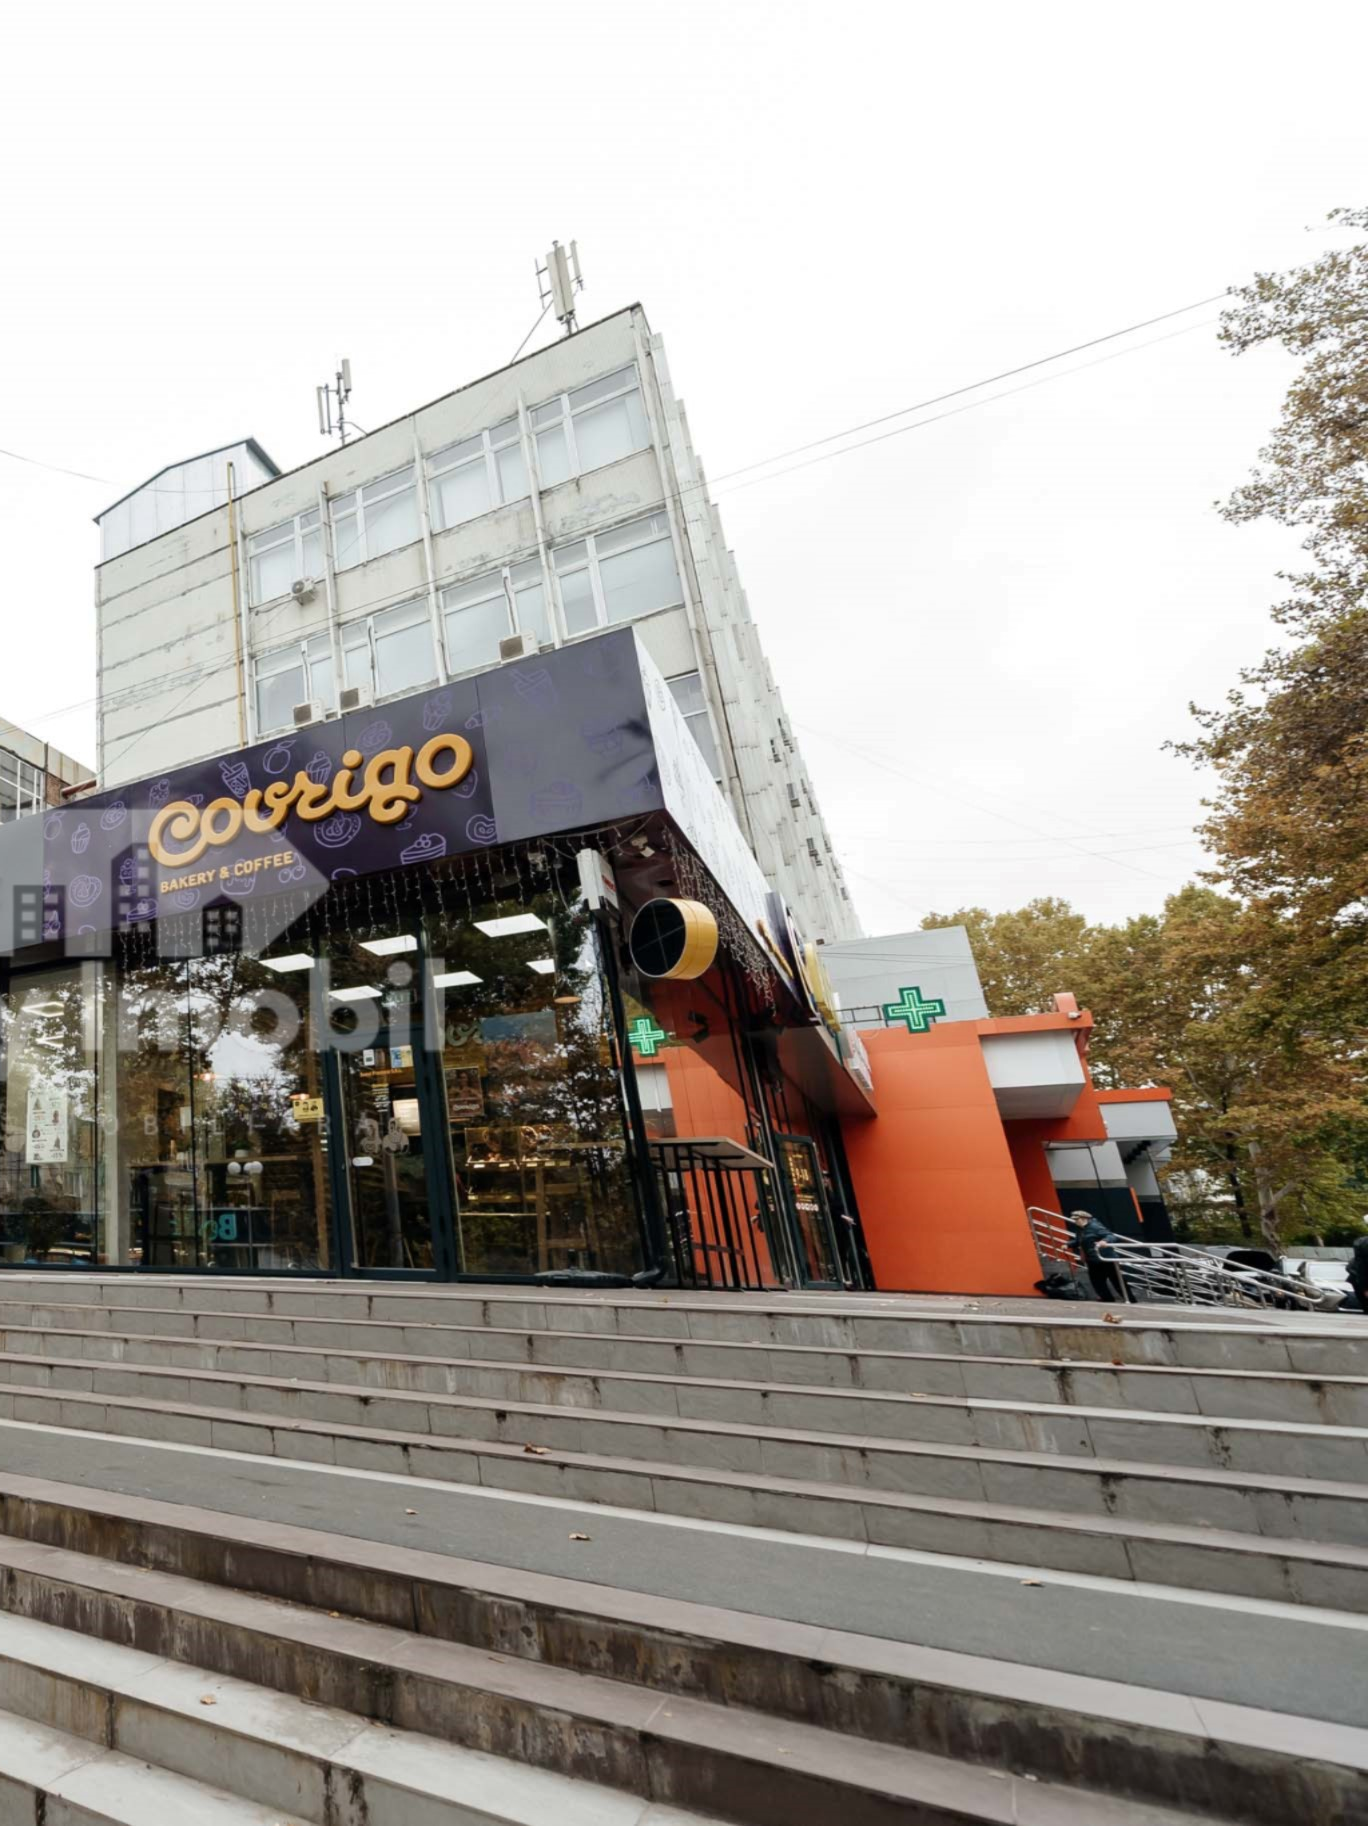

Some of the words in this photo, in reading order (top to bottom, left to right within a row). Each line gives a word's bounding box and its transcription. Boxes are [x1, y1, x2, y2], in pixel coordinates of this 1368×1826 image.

[148, 733, 474, 868] Covrigo
[160, 869, 217, 893] BAKERY
[219, 864, 230, 878] &
[233, 851, 294, 876] COFFEE
